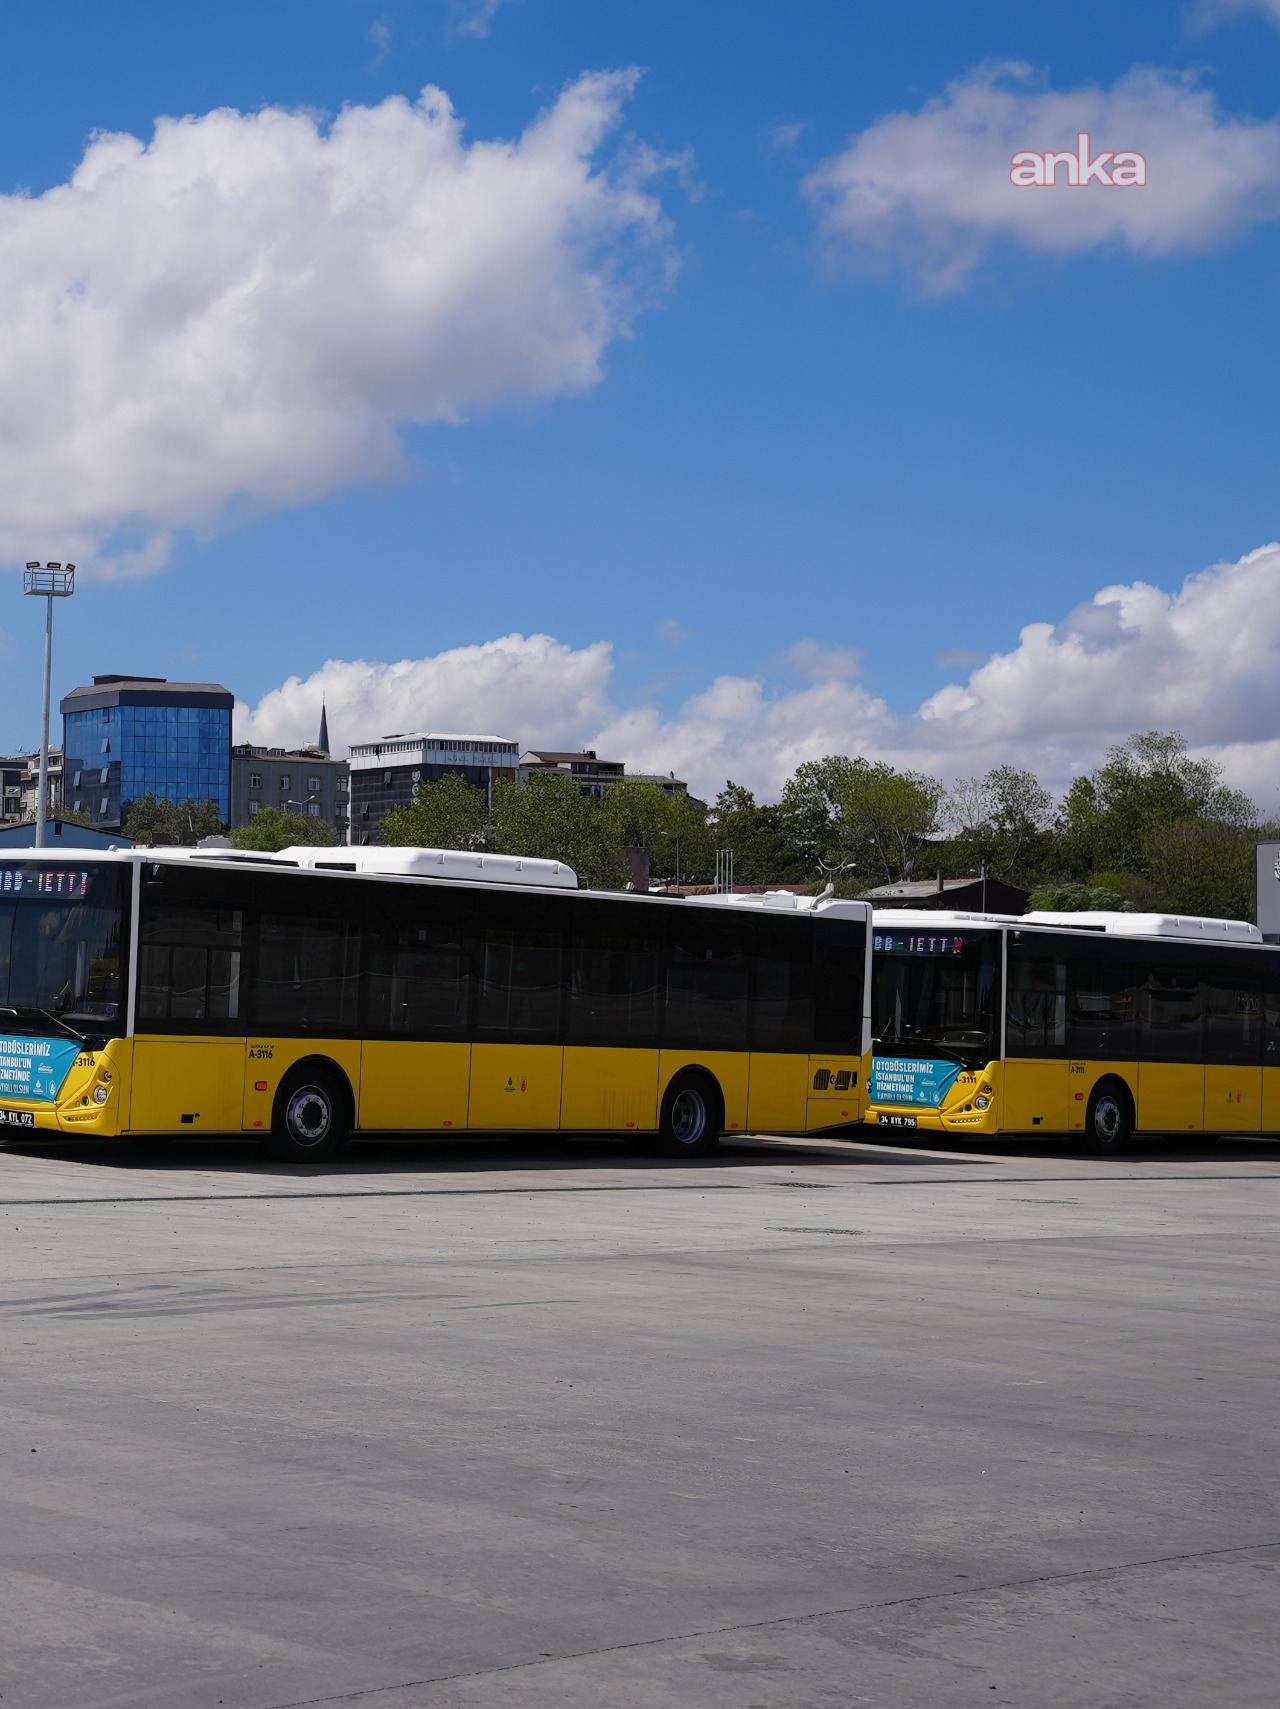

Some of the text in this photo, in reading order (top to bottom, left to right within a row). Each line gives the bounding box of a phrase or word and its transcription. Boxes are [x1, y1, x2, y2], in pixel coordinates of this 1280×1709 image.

[248, 1050, 273, 1059] A-3116
[876, 1060, 934, 1074] OTOBÜSLERİMİZ
[876, 1071, 914, 1083] İSTANBUL'UN
[876, 1081, 914, 1092] HİZMETİNDE
[0, 1110, 6, 1120] 34
[881, 1115, 889, 1124] 34
